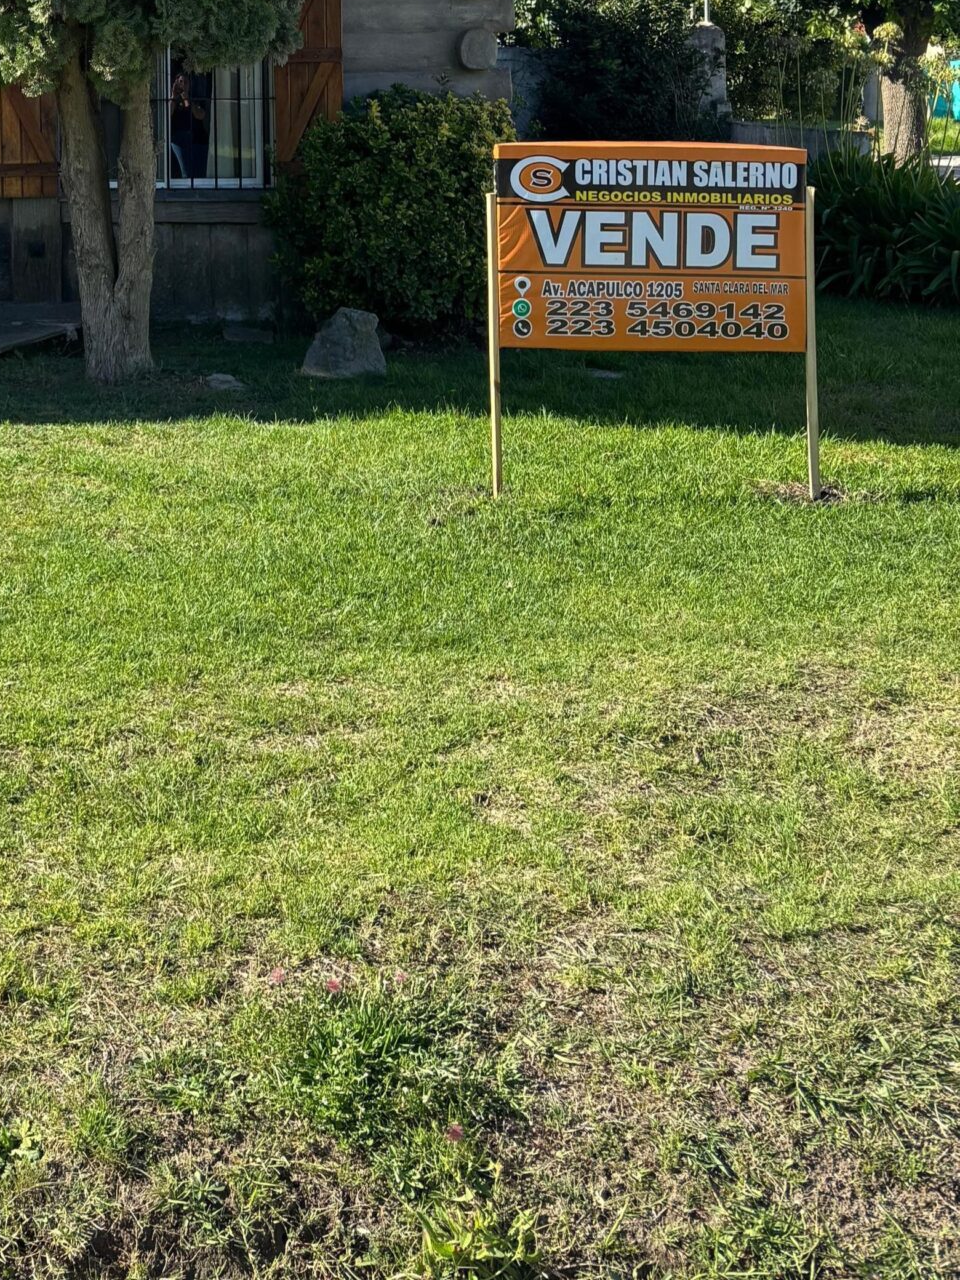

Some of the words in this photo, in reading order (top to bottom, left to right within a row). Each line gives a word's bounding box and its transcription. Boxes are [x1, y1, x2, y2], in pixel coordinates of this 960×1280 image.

[574, 158, 687, 187] CRISTIAN
[693, 159, 798, 189] SALERNO
[575, 190, 661, 202] NEGOCIOS
[667, 191, 793, 205] INMOBILIARIOS
[527, 208, 779, 270] VENDE
[542, 279, 564, 297] Av.
[567, 279, 643, 298] ACAPULCO
[646, 281, 683, 299] 1205
[693, 281, 721, 294] SANTA
[723, 282, 750, 294] CLARA
[751, 283, 768, 295] DEL
[770, 282, 789, 295] MAR
[545, 299, 614, 318] 223
[625, 300, 785, 321] 5469142
[545, 317, 616, 336] 223
[626, 318, 789, 339] 4504040
